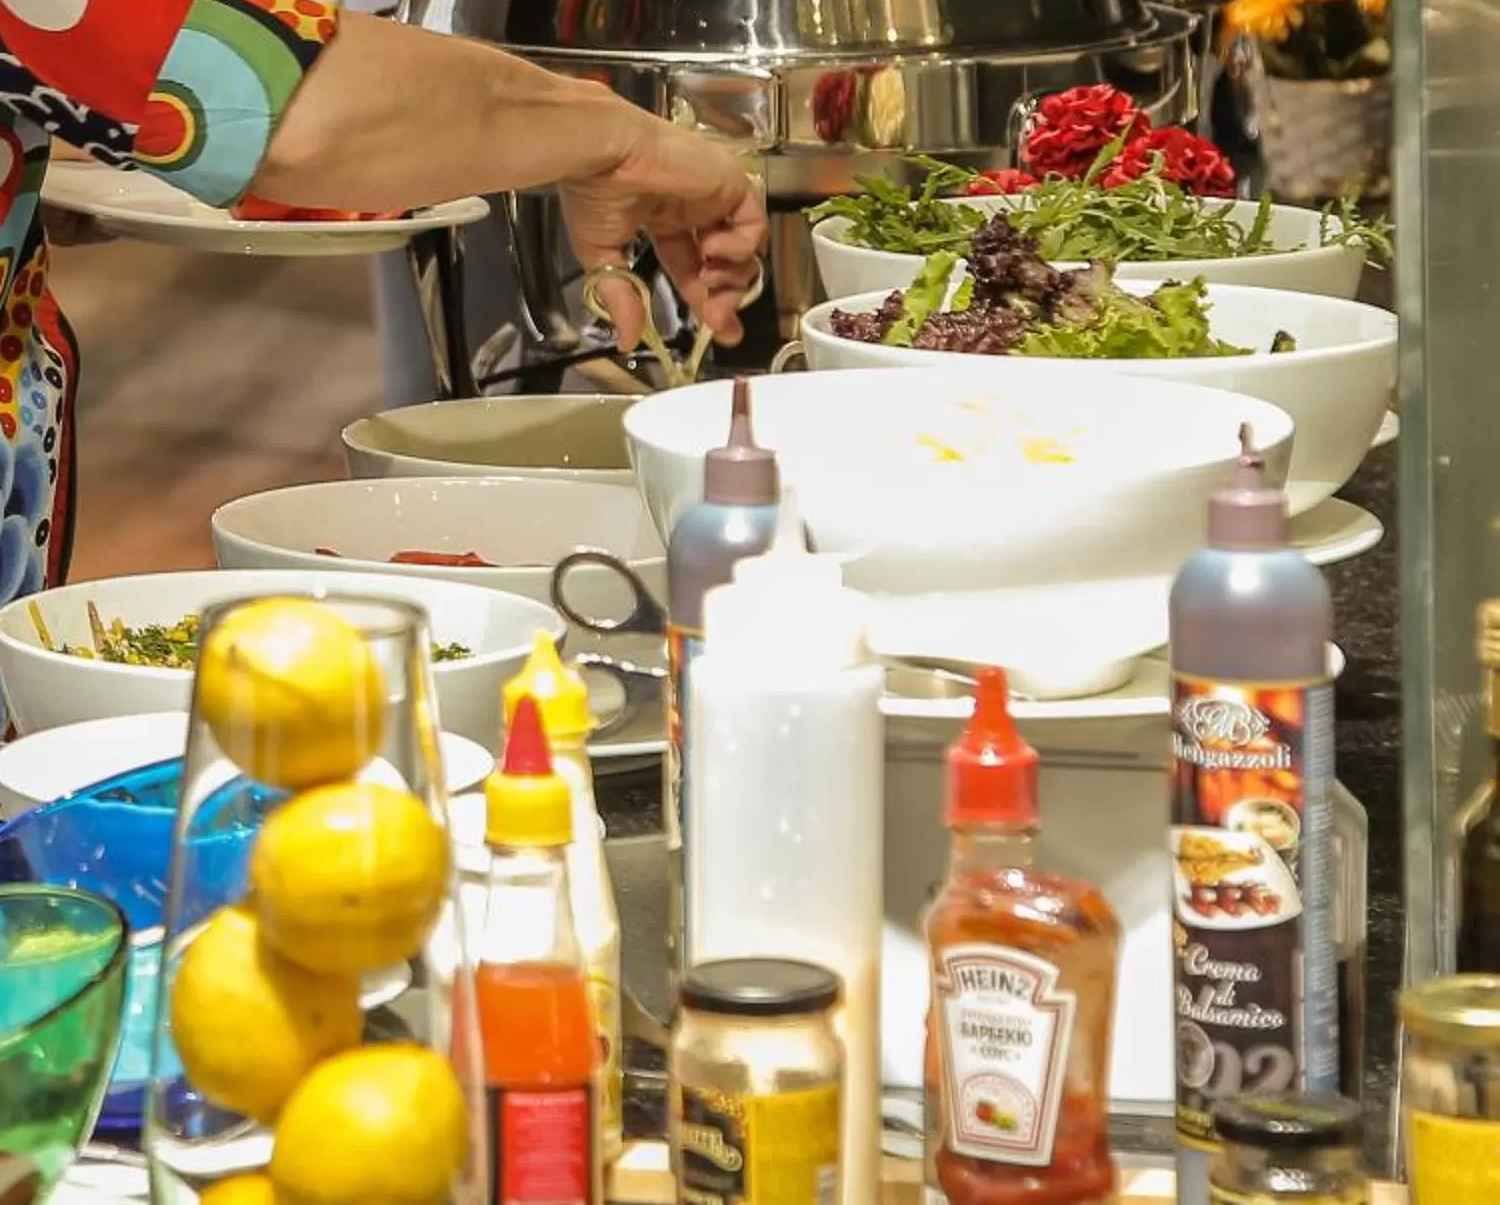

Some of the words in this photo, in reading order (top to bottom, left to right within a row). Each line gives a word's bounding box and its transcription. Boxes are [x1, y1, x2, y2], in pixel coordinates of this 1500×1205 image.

[1185, 944, 1262, 982] Crema
[960, 968, 1031, 1000] HEINZ
[1216, 980, 1236, 1006] di
[1179, 983, 1285, 1029] Balsamico
